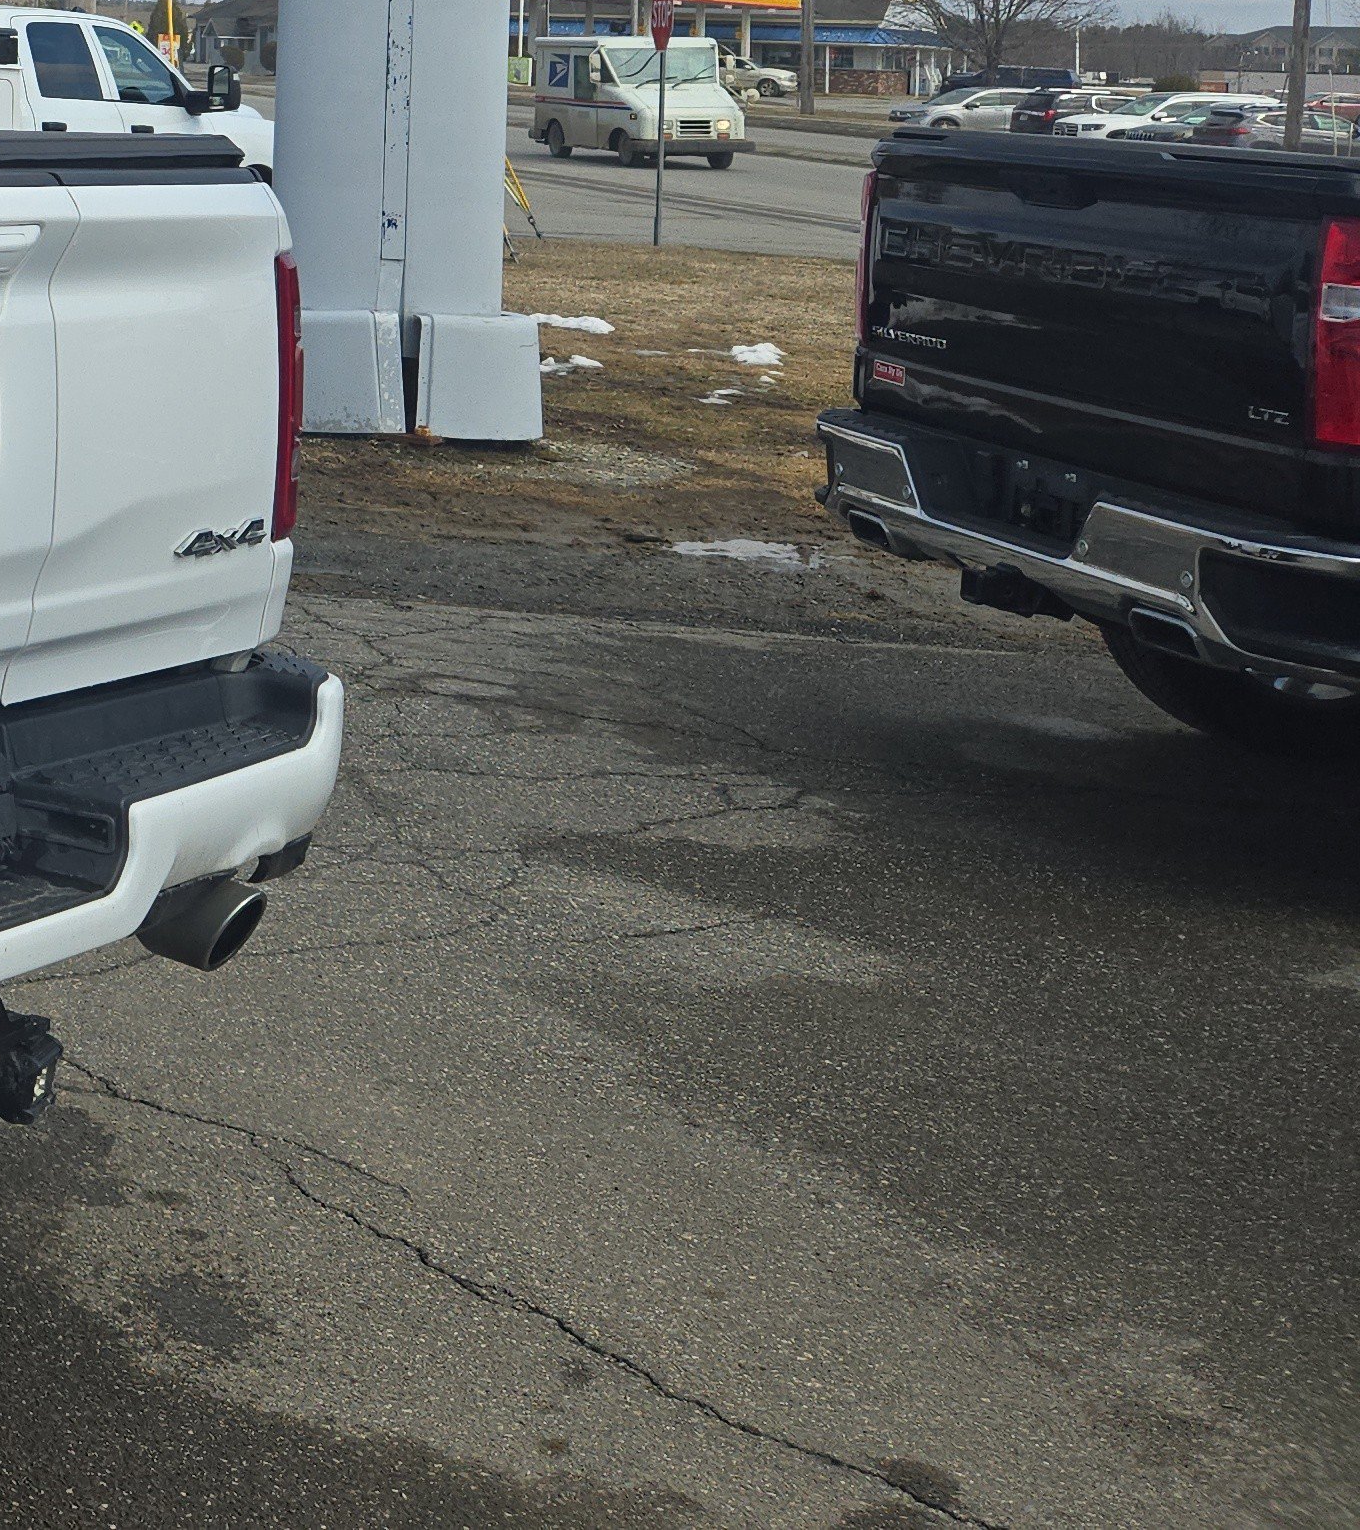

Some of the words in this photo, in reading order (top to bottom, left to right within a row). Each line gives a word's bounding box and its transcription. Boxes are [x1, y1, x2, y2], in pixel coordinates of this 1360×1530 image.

[652, 0, 673, 28] STOP
[872, 325, 947, 350] SILVERADO
[1247, 405, 1290, 425] LTZ
